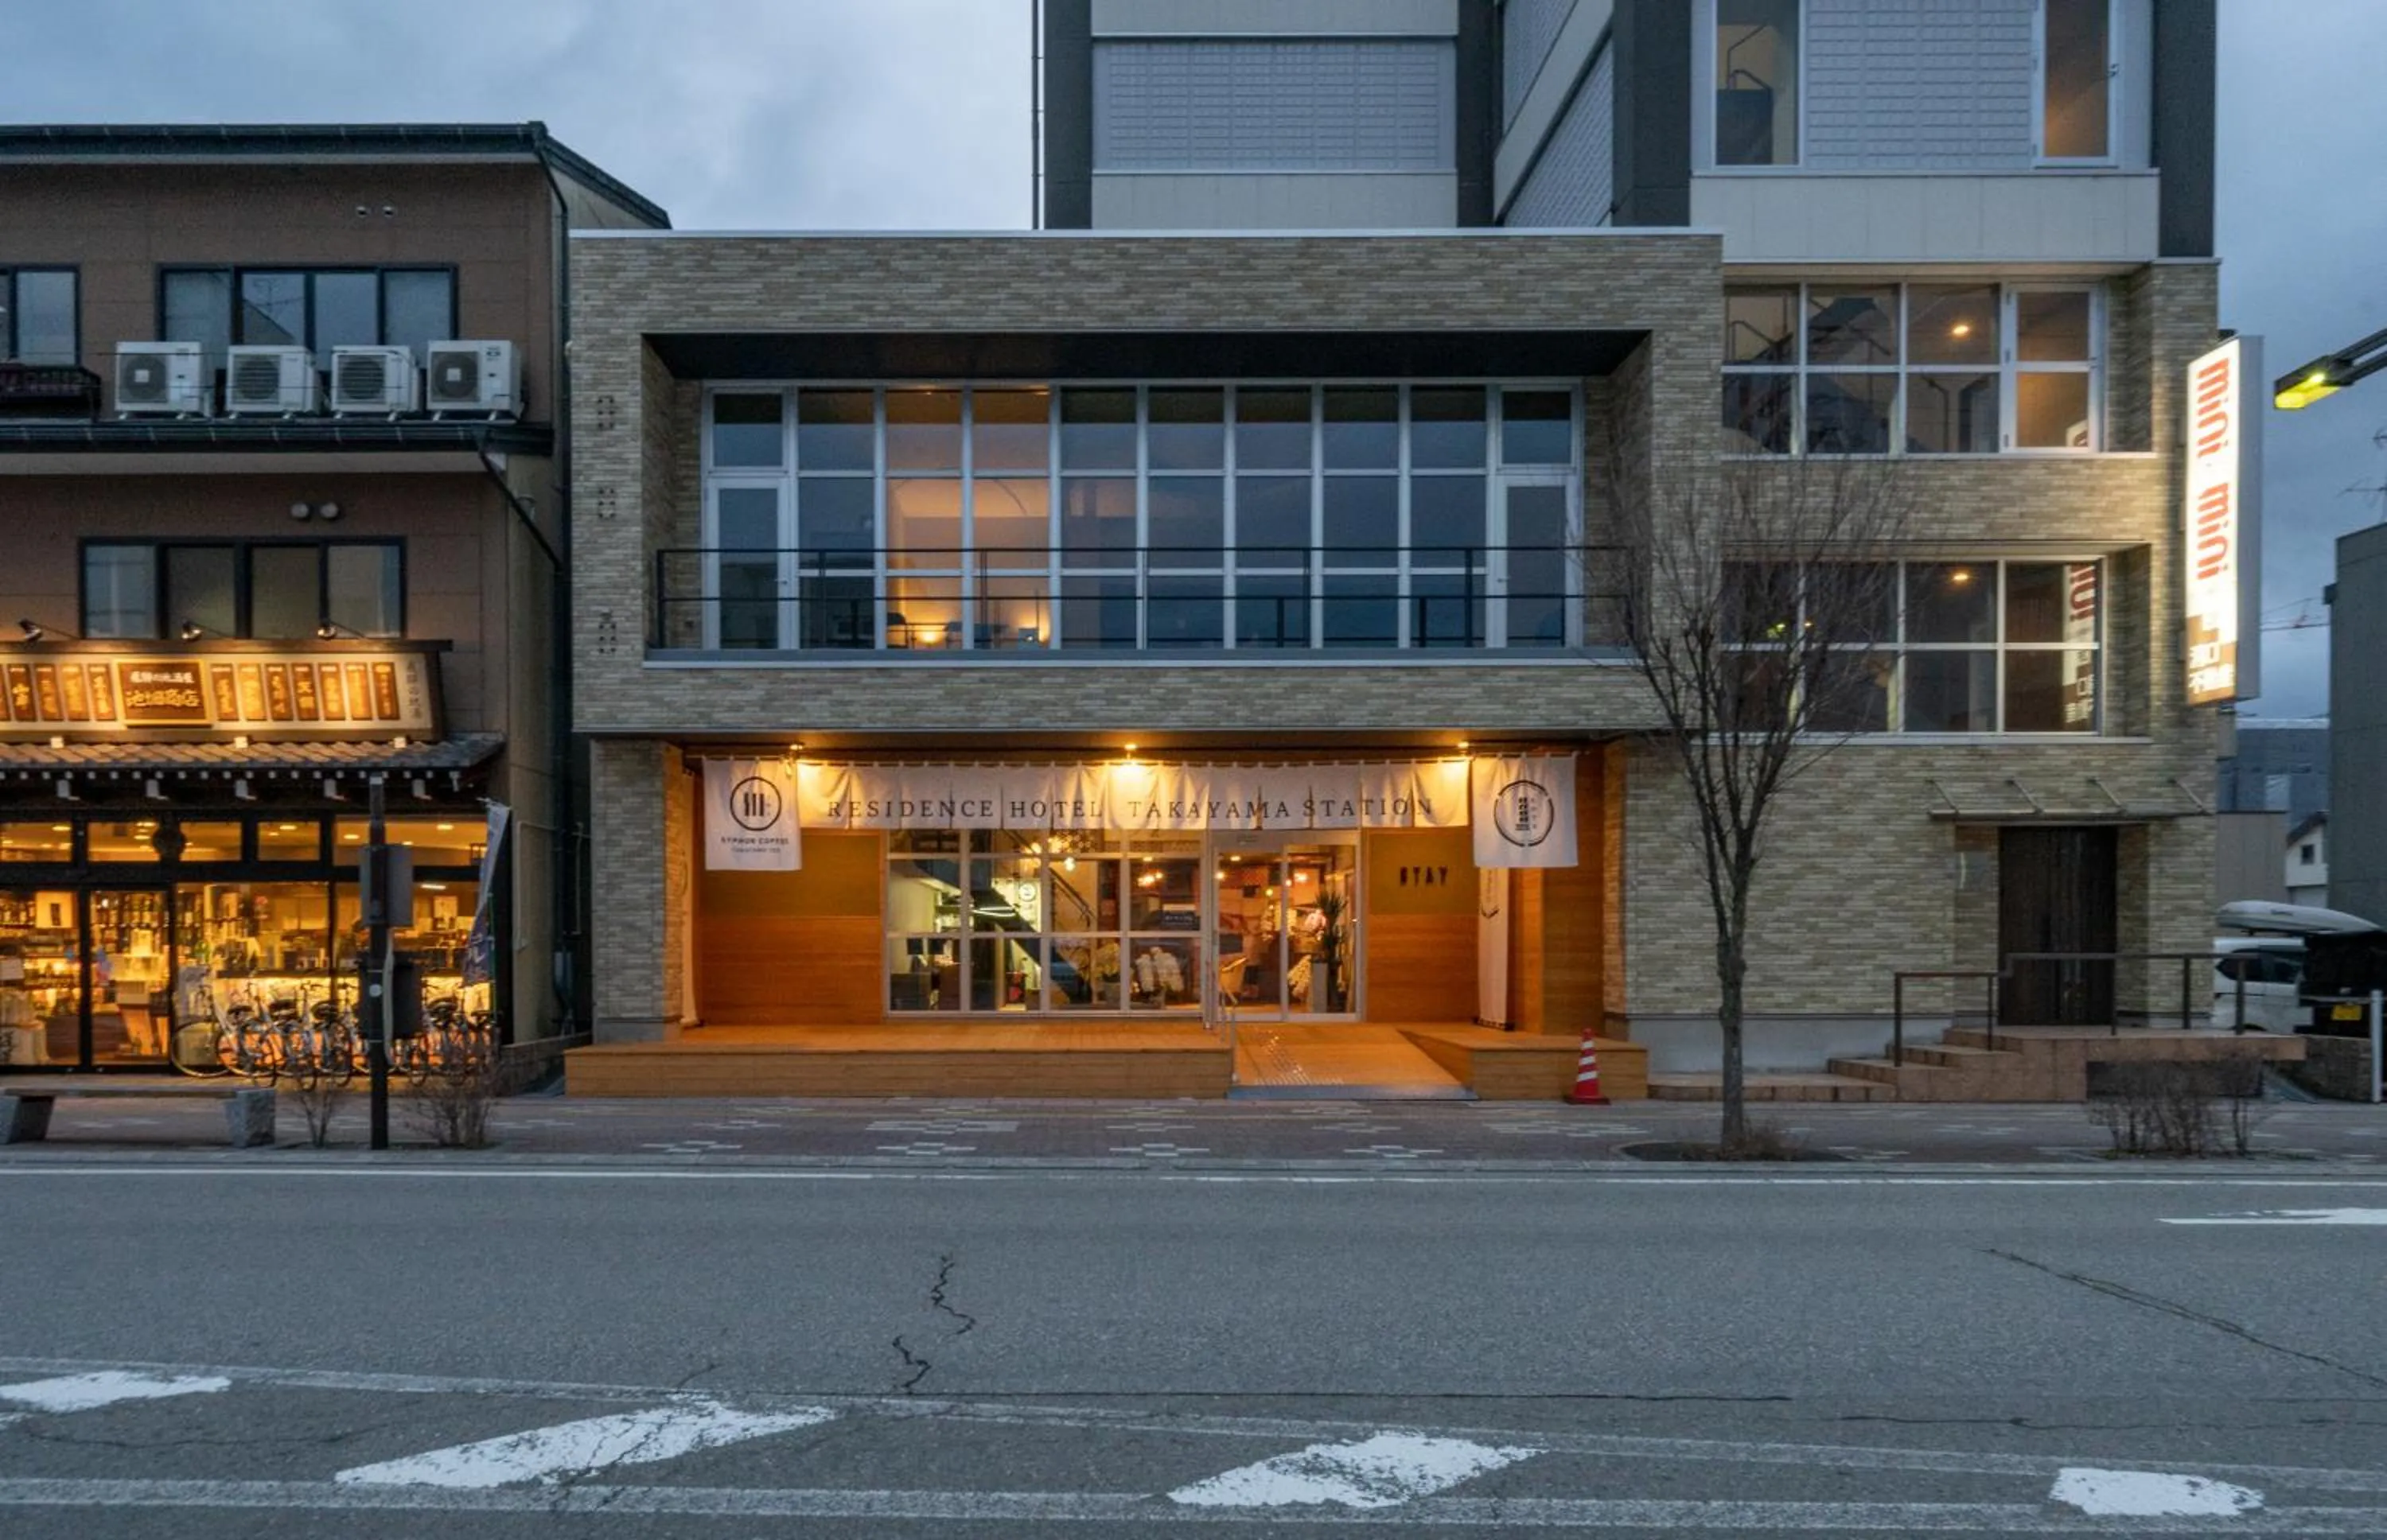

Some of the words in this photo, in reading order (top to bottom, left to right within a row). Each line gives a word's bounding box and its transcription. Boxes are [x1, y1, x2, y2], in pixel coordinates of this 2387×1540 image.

[2196, 357, 2231, 459] mini
[2196, 483, 2231, 581] mini
[827, 800, 994, 819] RESIDENCE
[1009, 800, 1104, 819] HOTEL
[1127, 798, 1291, 819] TAKAYAMA
[1303, 797, 1434, 818] STATION
